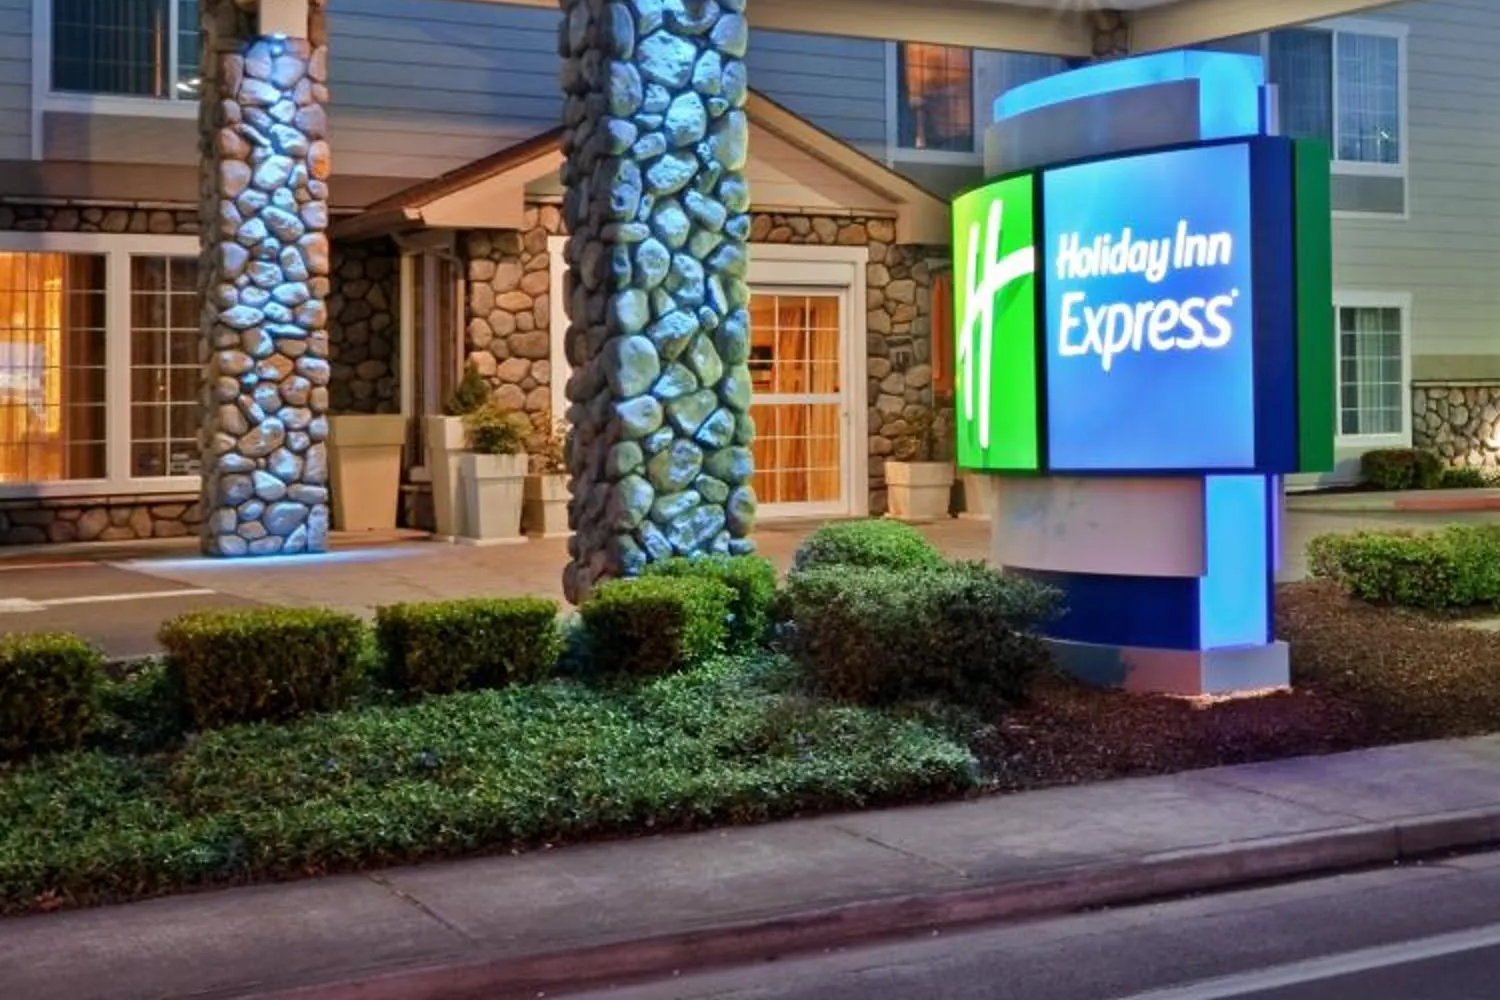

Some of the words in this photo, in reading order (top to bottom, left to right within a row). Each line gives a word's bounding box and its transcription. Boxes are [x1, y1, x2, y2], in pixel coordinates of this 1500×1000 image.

[1056, 226, 1170, 284] Holiday
[1173, 219, 1232, 269] Inn
[1057, 290, 1235, 373] Express
